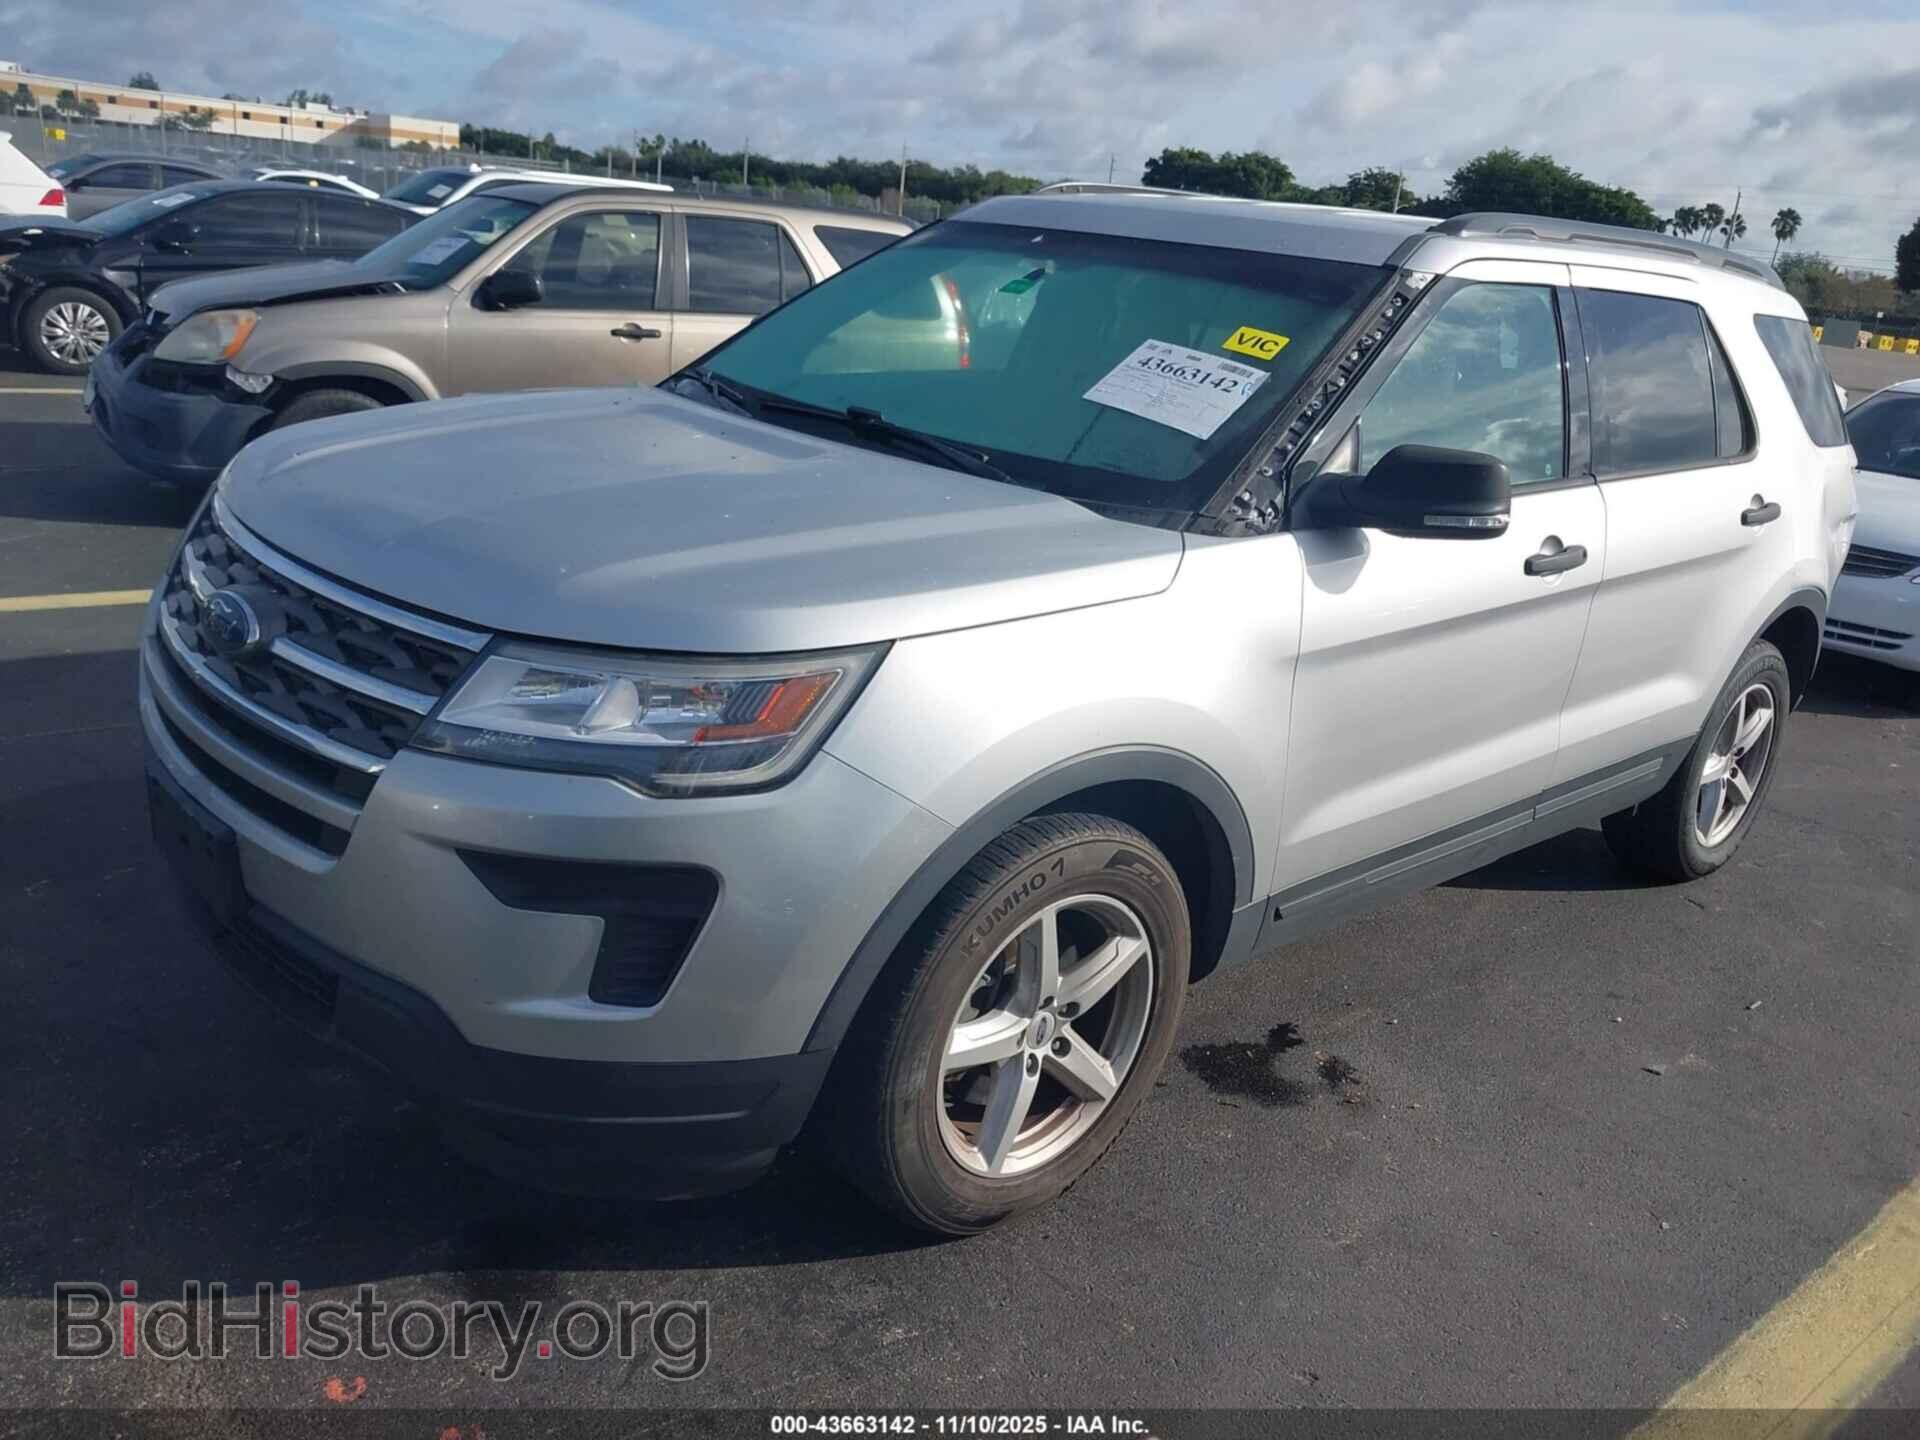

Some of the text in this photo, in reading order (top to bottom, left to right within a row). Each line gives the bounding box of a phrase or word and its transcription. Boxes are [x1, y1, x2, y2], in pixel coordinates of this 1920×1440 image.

[1237, 332, 1279, 353] VIC
[1137, 356, 1238, 394] 43663142
[961, 872, 1047, 958] KUMHO
